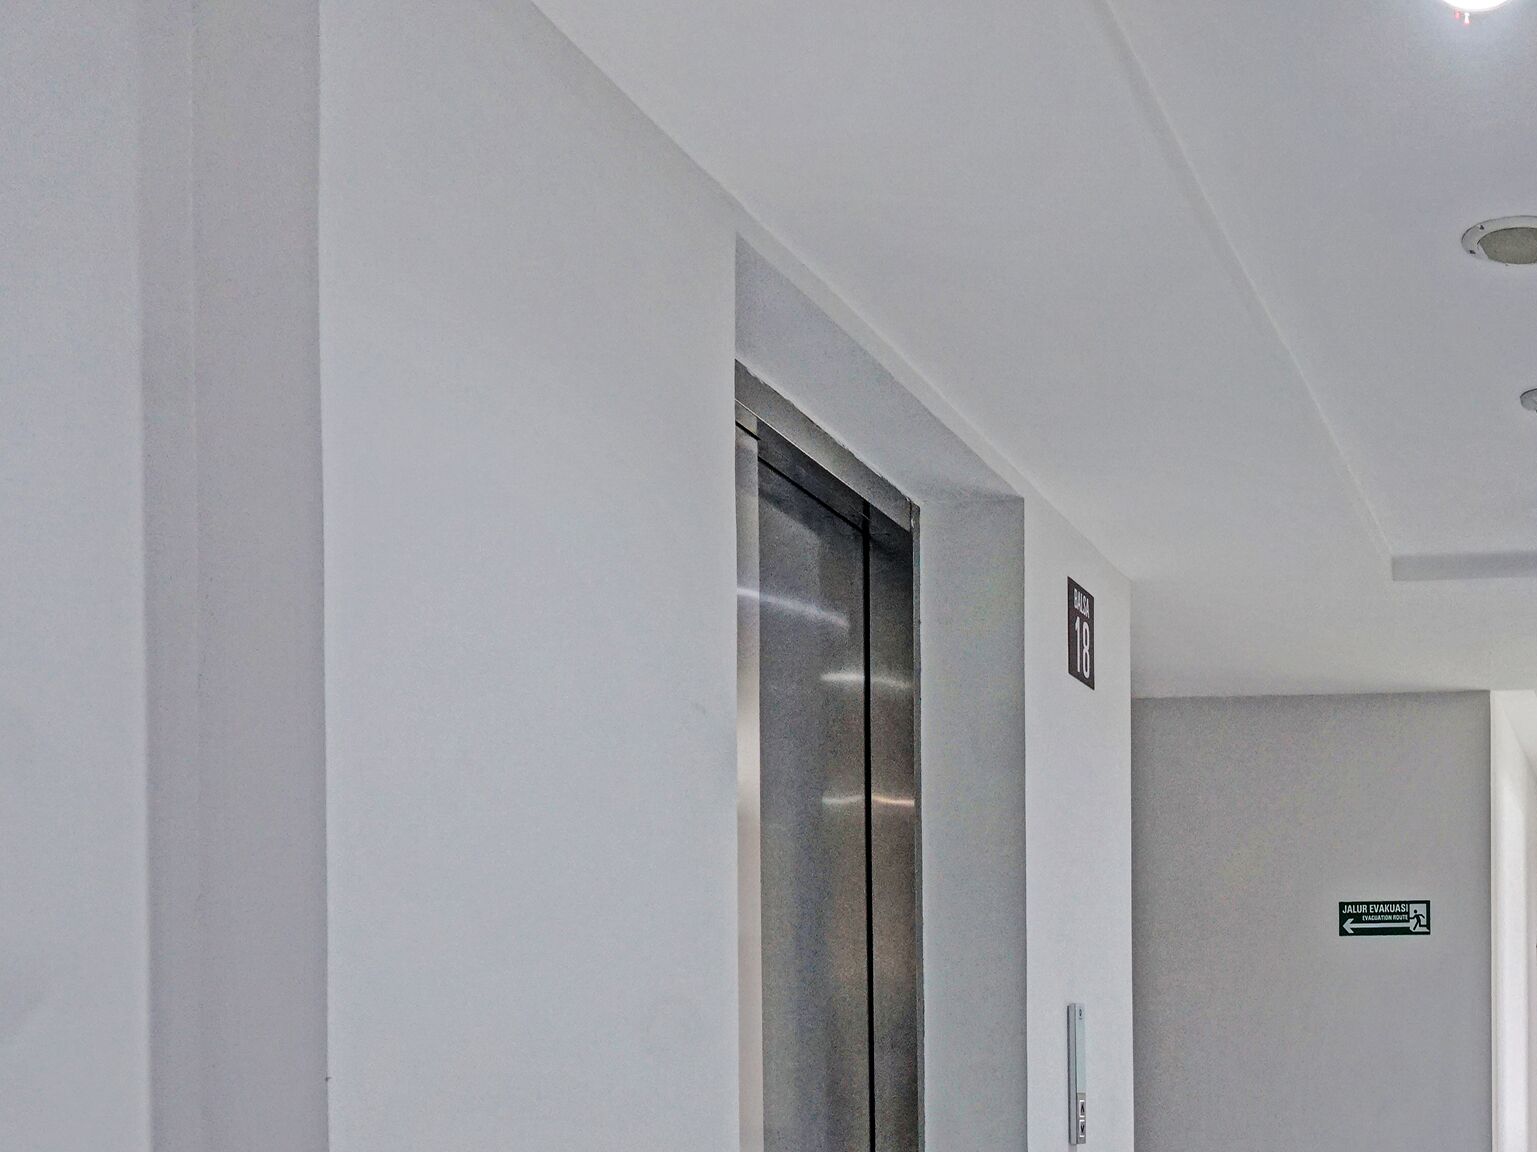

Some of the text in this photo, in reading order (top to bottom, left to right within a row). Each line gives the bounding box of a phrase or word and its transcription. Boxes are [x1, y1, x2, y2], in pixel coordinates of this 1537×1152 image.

[1075, 616, 1090, 679] 18
[1342, 903, 1408, 914] JALUR EVAKUASI
